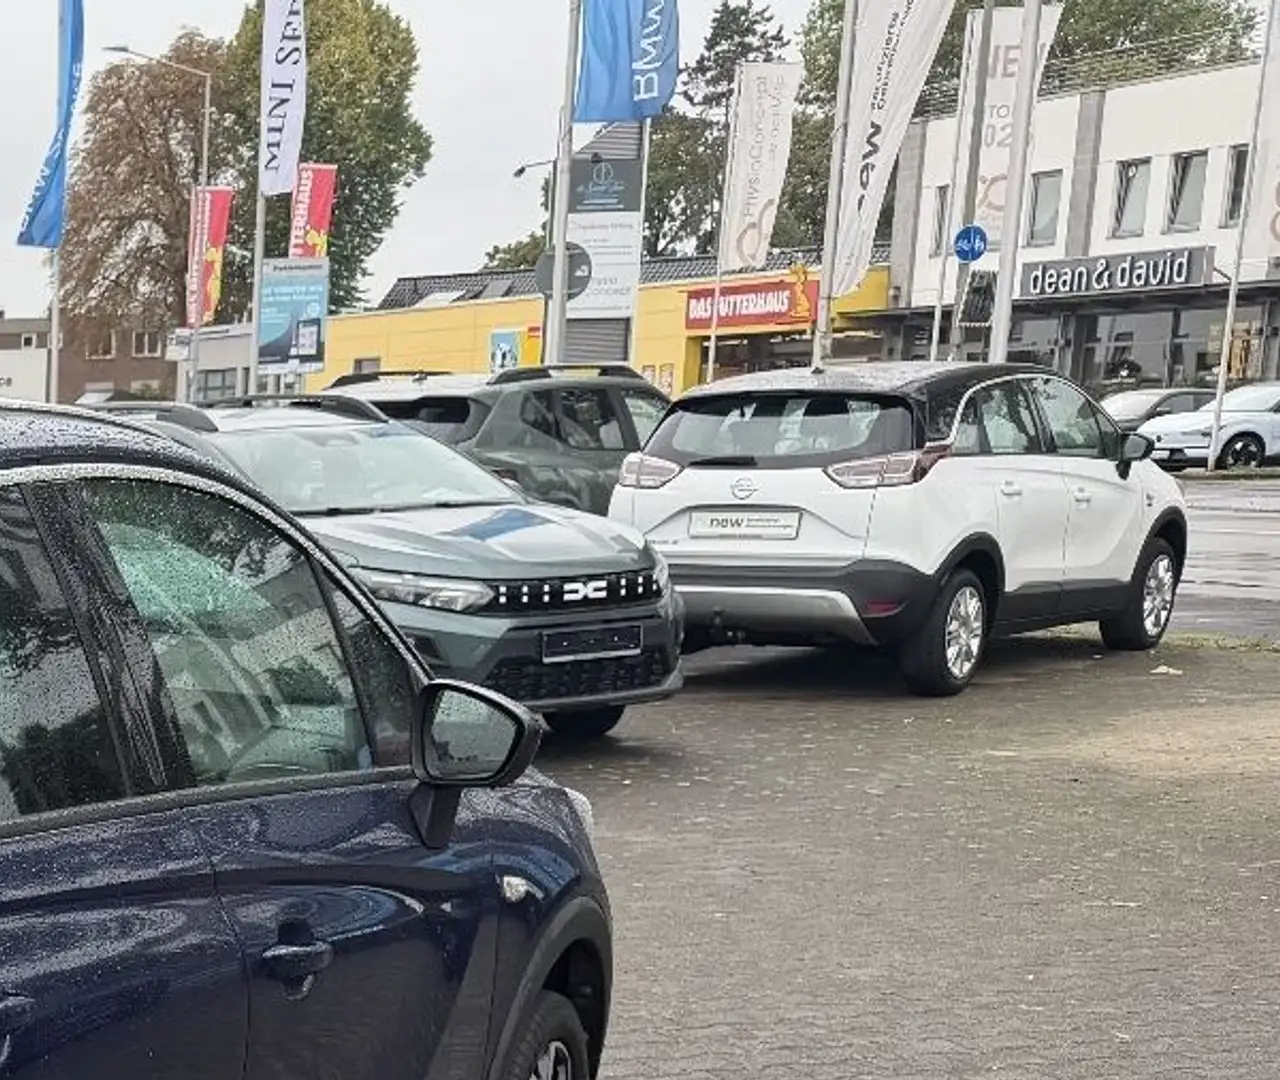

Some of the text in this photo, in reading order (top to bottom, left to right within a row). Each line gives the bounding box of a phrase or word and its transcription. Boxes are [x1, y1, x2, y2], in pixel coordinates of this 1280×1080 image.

[264, 78, 296, 173] MINI
[1030, 251, 1192, 294] dean & david
[691, 291, 790, 319] DAS UTTERHAUS
